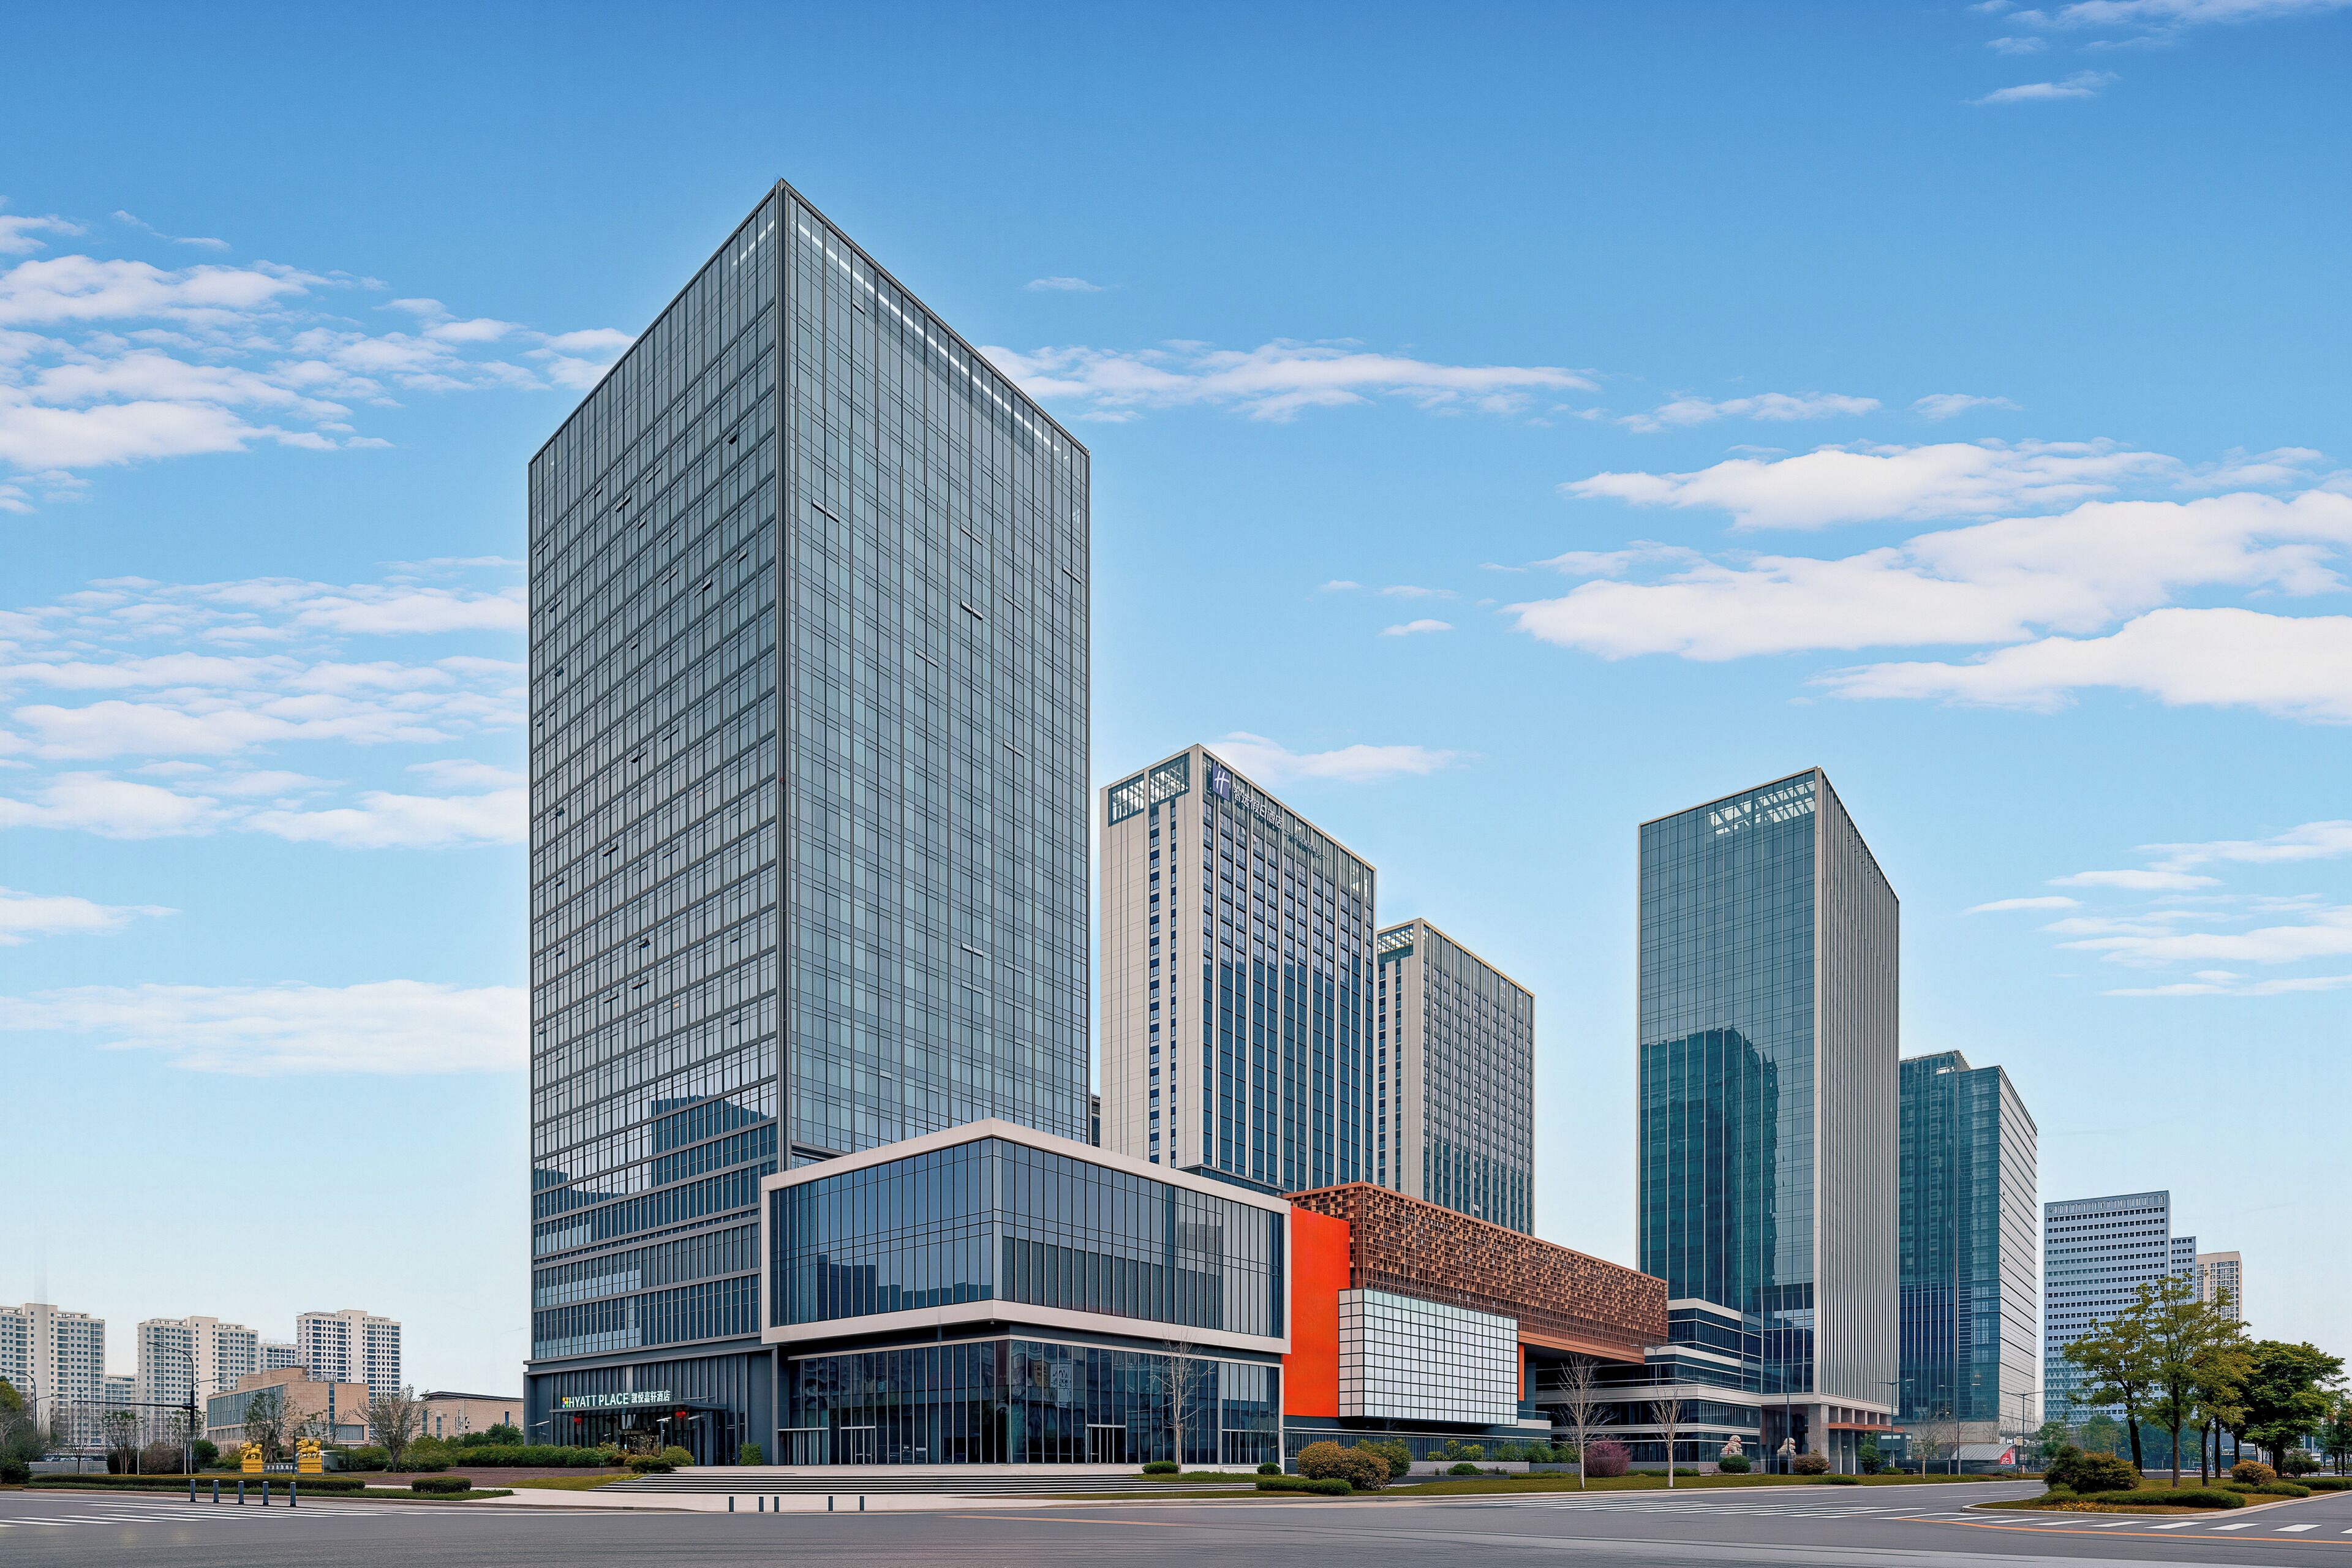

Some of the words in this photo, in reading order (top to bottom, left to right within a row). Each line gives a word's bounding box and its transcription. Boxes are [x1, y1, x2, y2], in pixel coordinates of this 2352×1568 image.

[1233, 786, 1283, 829] 智选假日酒店
[568, 1395, 597, 1408] HYATT
[599, 1392, 629, 1406] PLACE
[631, 1390, 671, 1404] 凯悦嘉轩酒店
